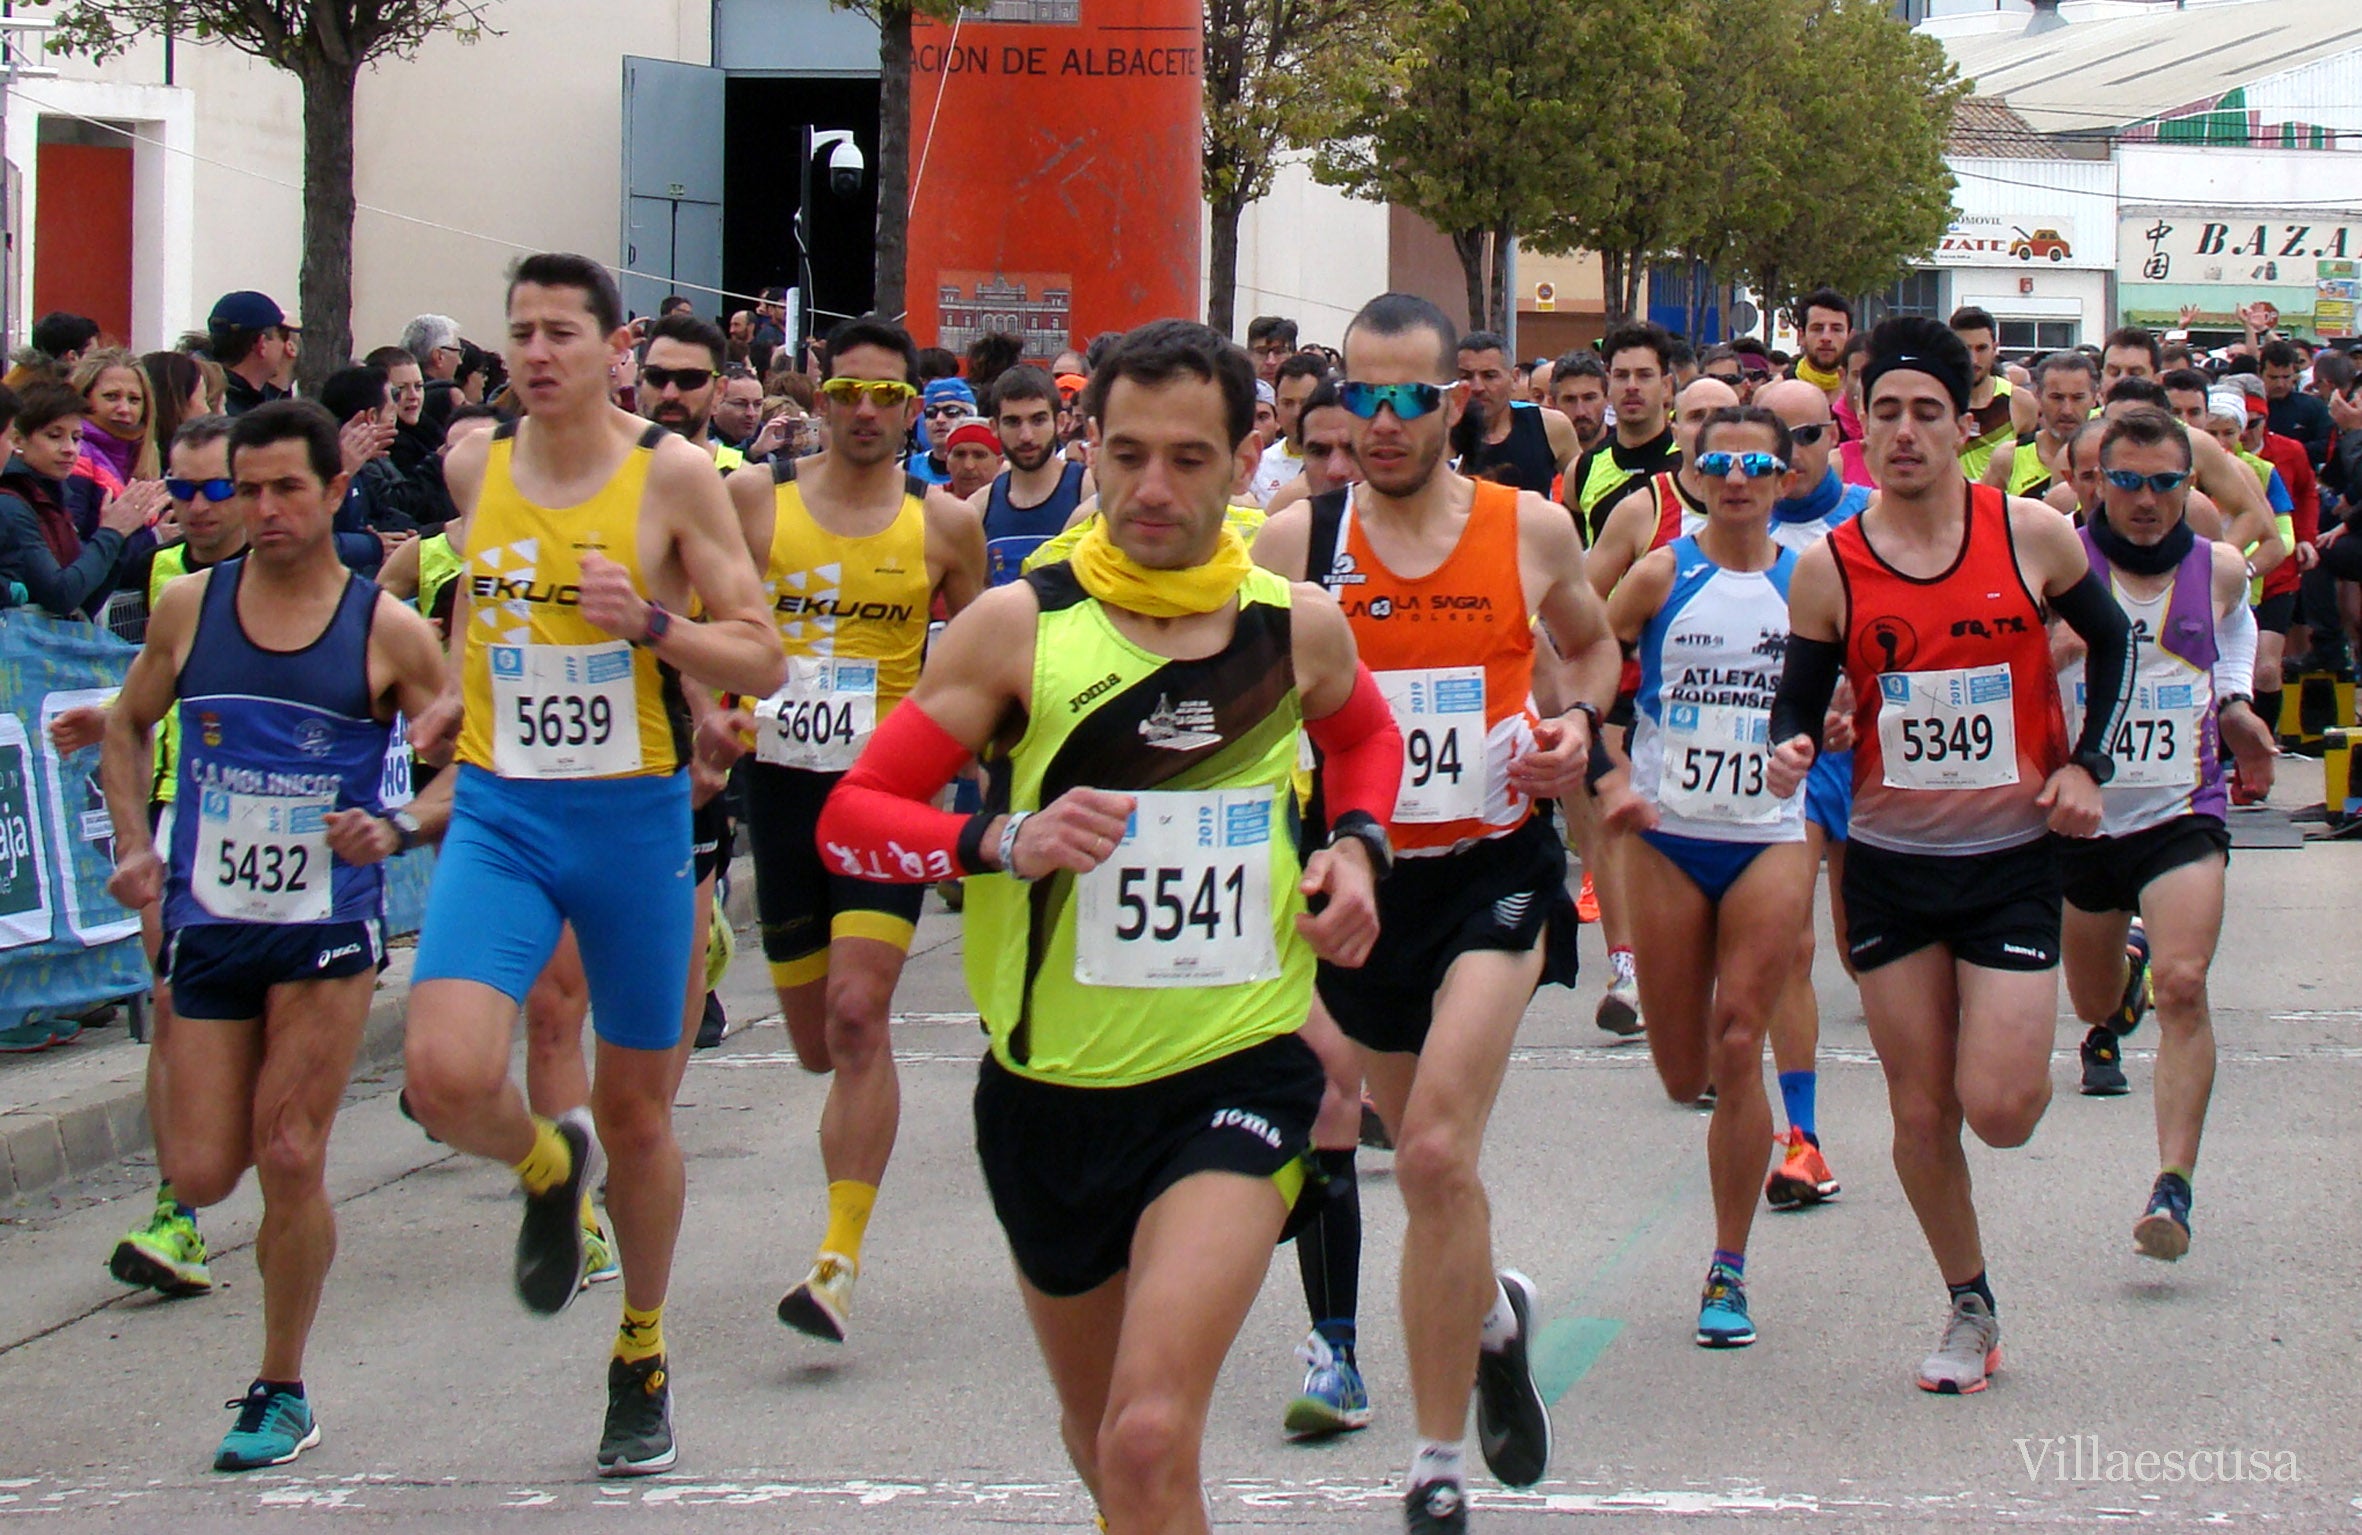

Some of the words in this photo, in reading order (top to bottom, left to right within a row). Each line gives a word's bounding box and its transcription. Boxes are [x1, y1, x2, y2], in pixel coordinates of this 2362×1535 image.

[1003, 47, 1047, 75] DE
[1061, 48, 1197, 76] ALBACETE
[2143, 219, 2173, 280] 中国
[2194, 223, 2362, 259] BAZA
[1410, 681, 1424, 713] 2019
[1683, 668, 1781, 693] ATLETAS
[1950, 679, 1962, 705] 2019
[516, 694, 612, 747] 5639
[777, 700, 854, 745] 5604
[1902, 714, 1993, 762] 5349
[2116, 719, 2175, 762] 473
[1682, 748, 1763, 796] 5713
[1198, 806, 1213, 847] 2019
[218, 839, 308, 893] 5432
[1116, 864, 1245, 941] 5541
